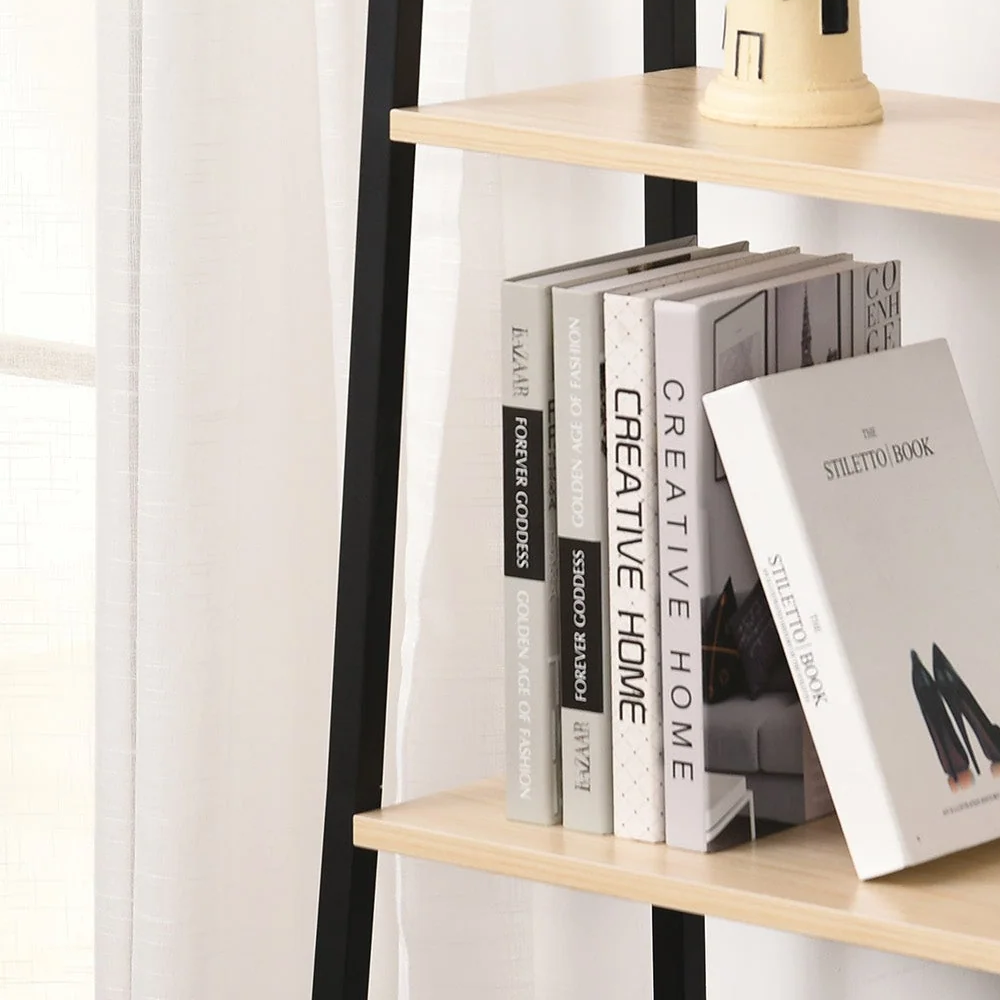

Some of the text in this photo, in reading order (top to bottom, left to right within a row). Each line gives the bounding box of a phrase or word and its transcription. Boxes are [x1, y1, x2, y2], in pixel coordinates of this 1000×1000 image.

[514, 416, 529, 569] FOREVER GODDESS
[568, 316, 584, 528] GOLDEN AGE OF FASHION
[823, 436, 934, 481] STILETTO BOOK
[571, 549, 588, 703] FOREVER GODDESS
[614, 387, 647, 725] CREATIVE HOME
[663, 379, 694, 781] CREATIVE HOME
[767, 553, 807, 644] STILETTO
[800, 651, 828, 708] BOOK
[516, 589, 533, 801] GOLDEN AGE OF FASHION
